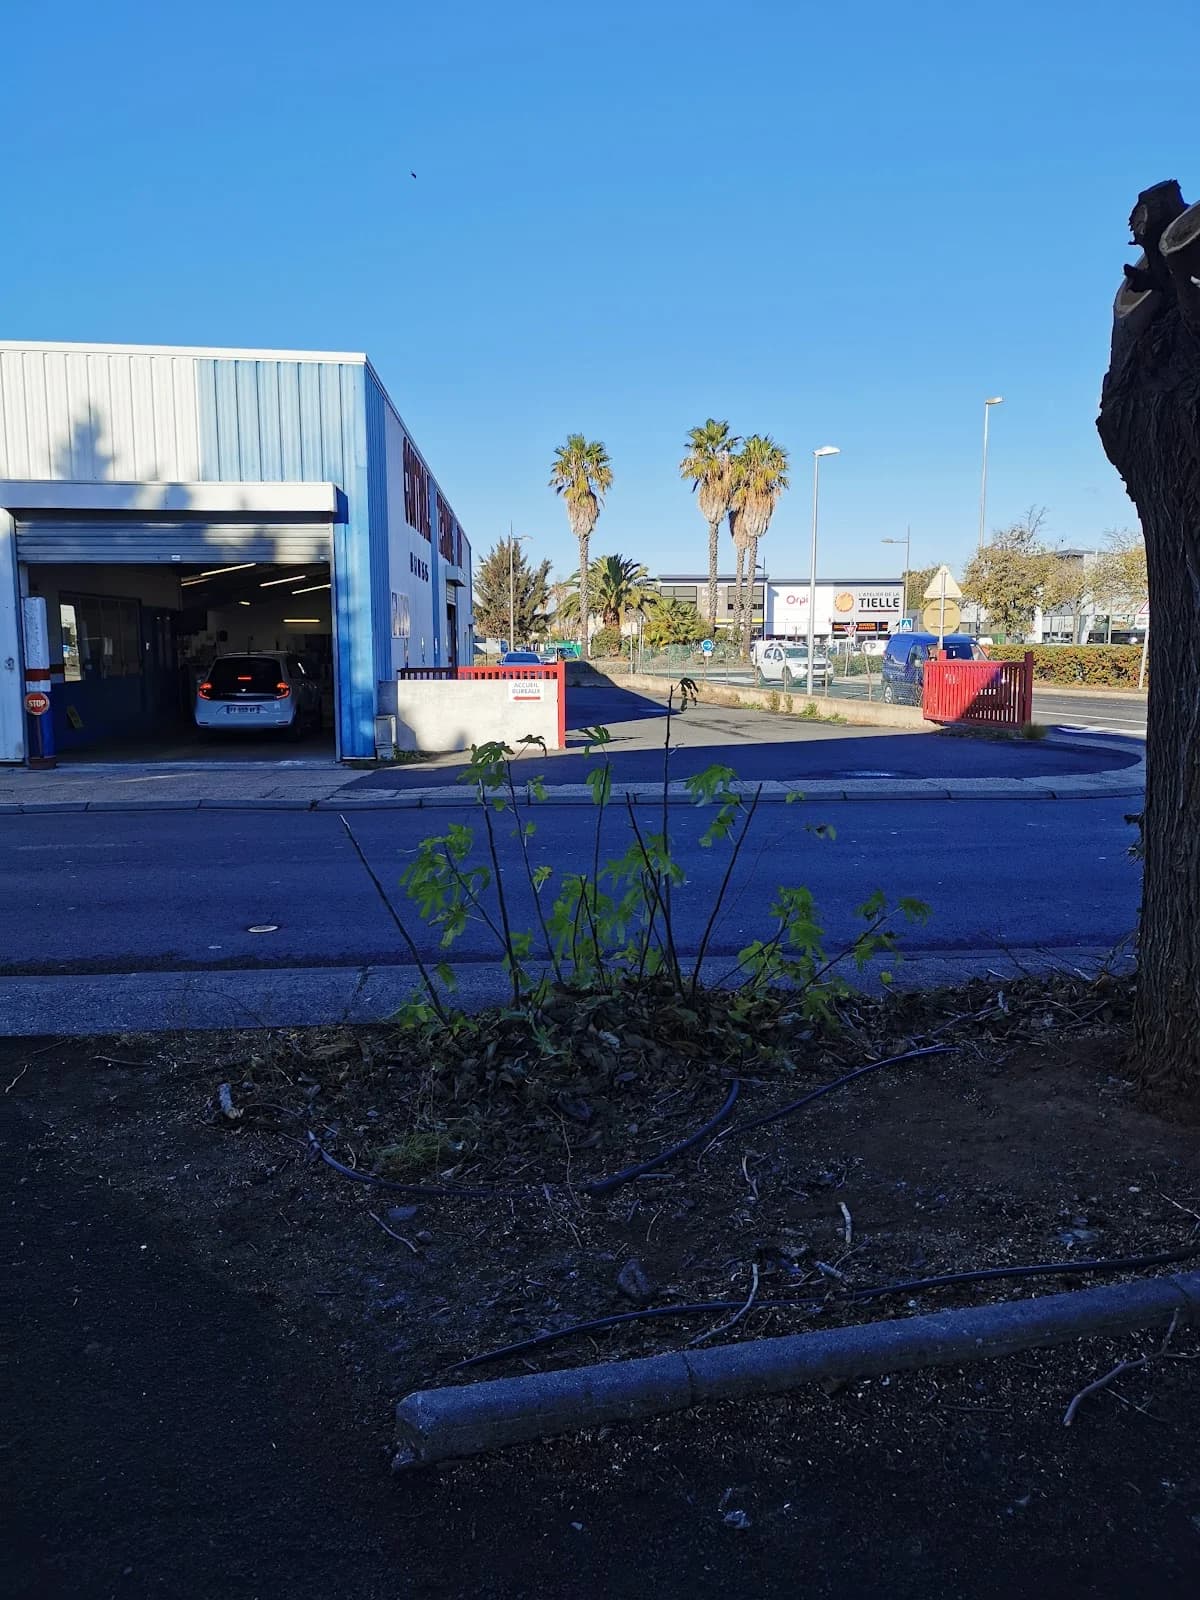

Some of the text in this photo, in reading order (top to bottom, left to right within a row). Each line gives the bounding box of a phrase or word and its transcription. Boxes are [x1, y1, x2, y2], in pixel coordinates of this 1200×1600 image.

[786, 594, 809, 605] Orpi
[858, 597, 900, 608] TIELLE
[28, 699, 46, 707] STOP
